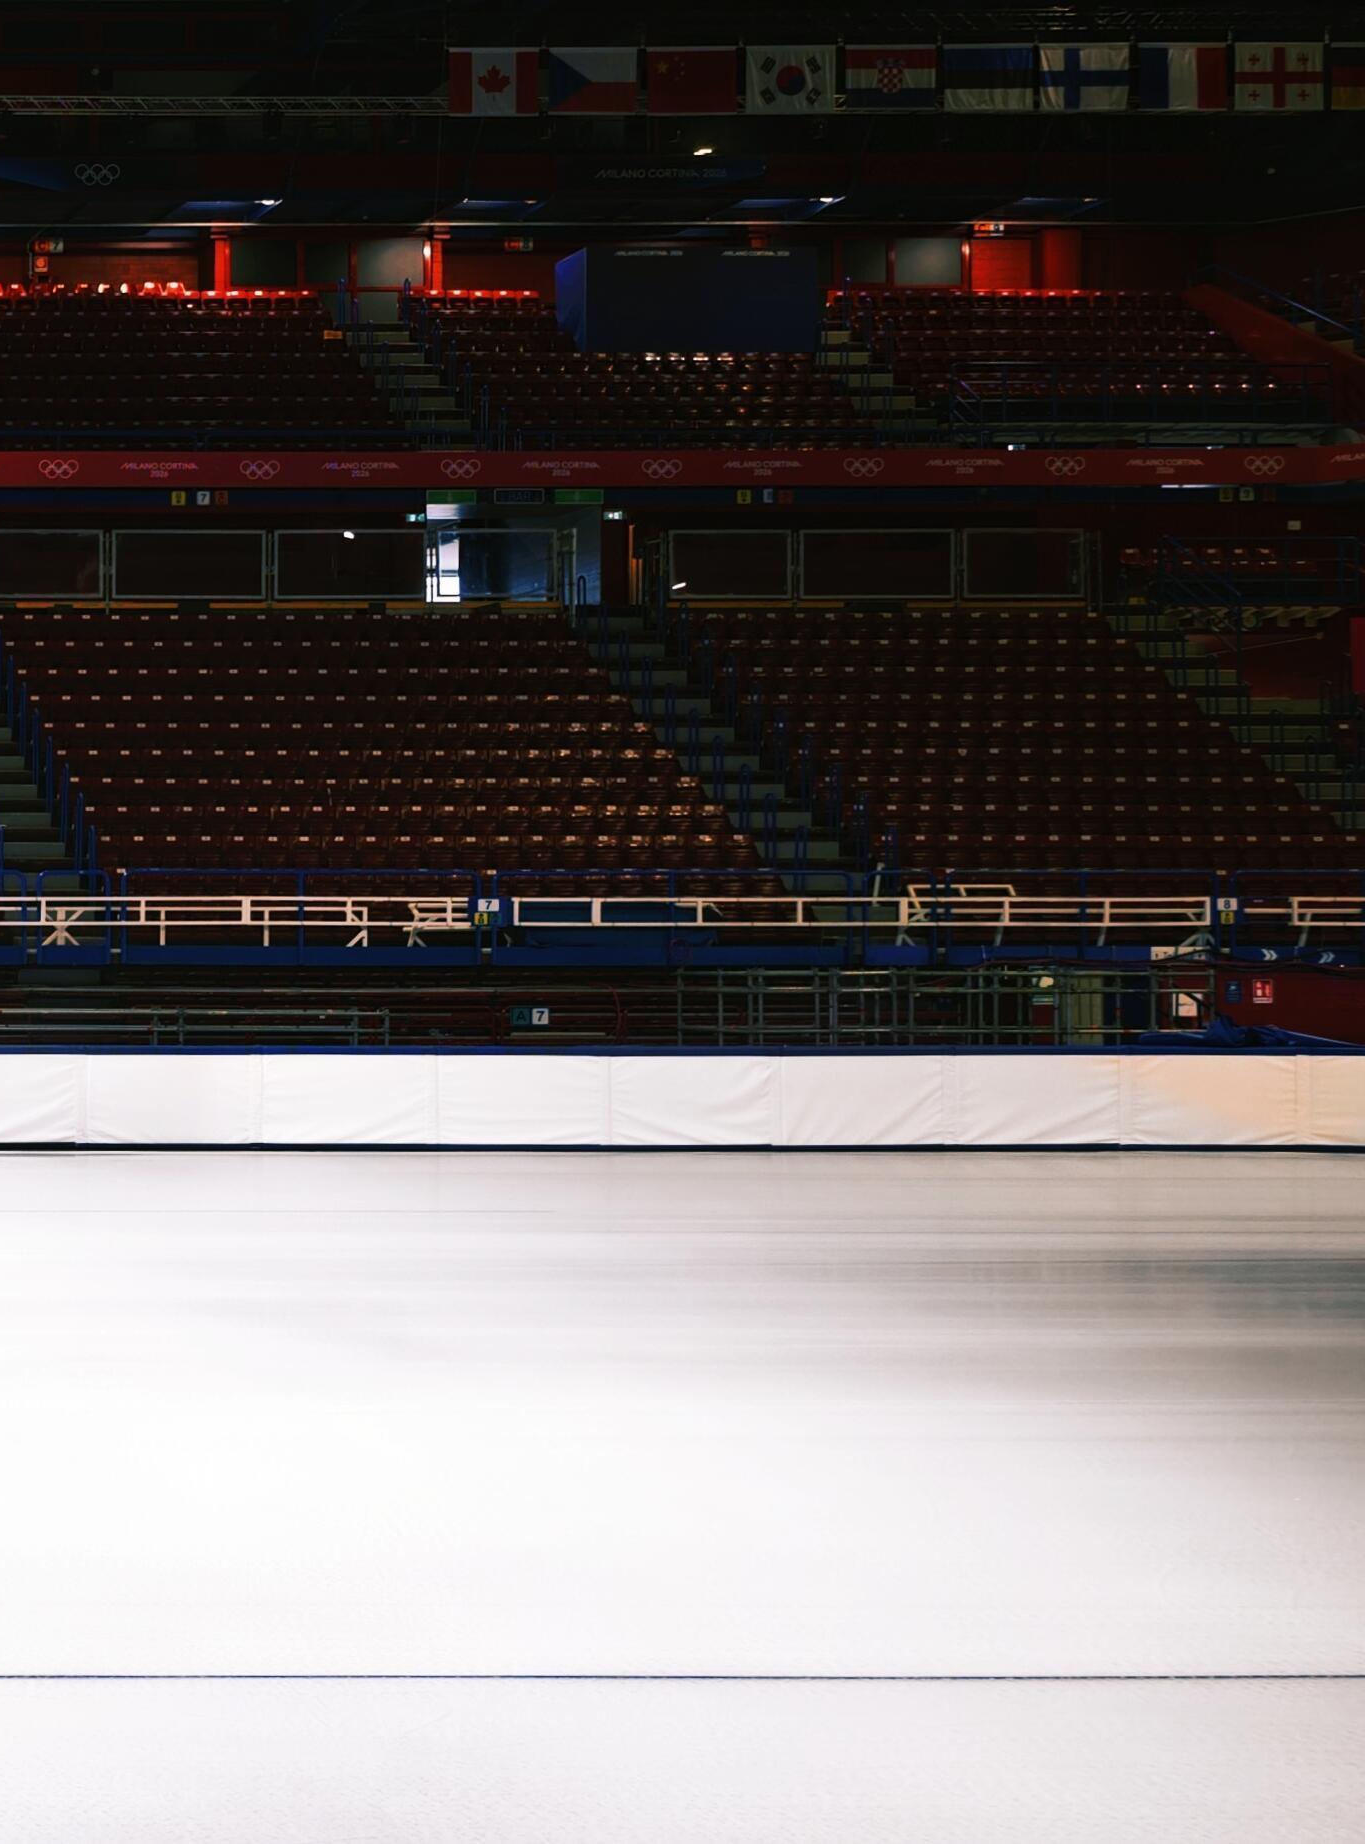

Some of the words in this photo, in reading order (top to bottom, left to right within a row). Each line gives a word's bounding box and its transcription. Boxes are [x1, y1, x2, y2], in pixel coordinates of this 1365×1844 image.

[594, 168, 646, 178] MILANO
[647, 168, 700, 178] CORTINA
[121, 462, 158, 470] MILANO
[159, 462, 199, 470] CORTINA
[322, 462, 359, 470] MILANO
[360, 462, 400, 470] CORTINA
[926, 458, 964, 466] MILANO
[964, 458, 1005, 466] CORTINA
[516, 1011, 526, 1021] A
[536, 1011, 544, 1021] 7
